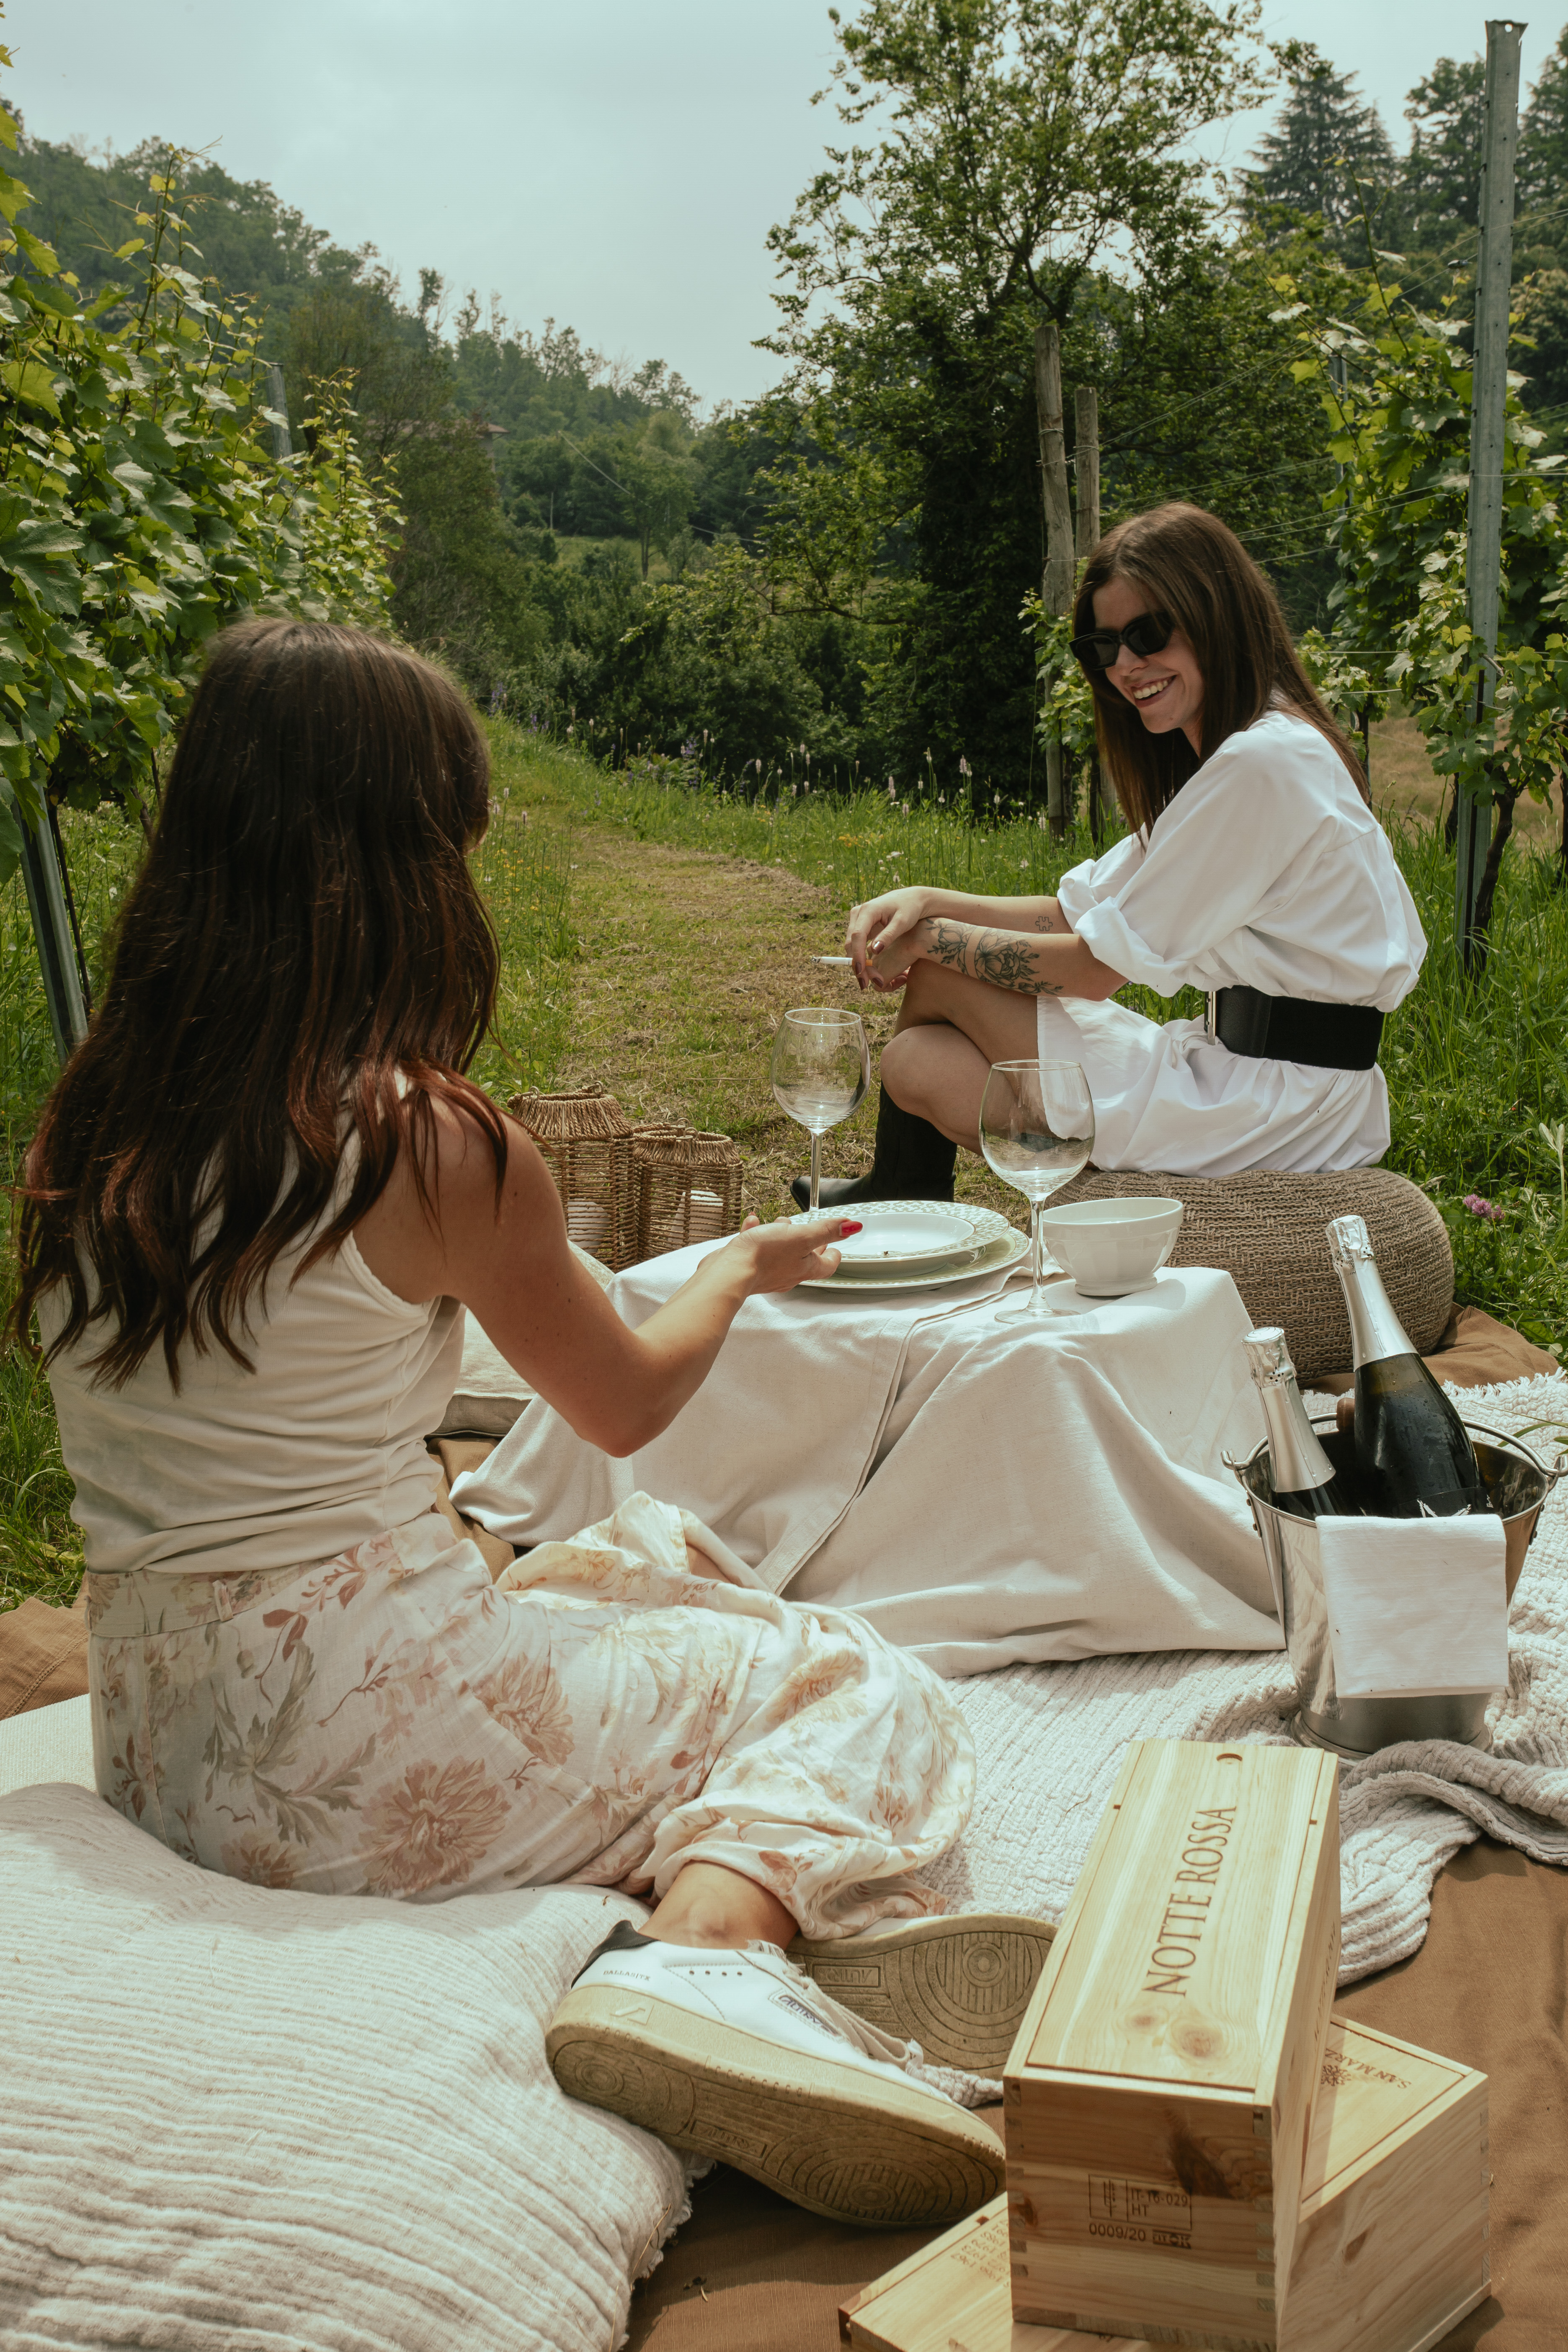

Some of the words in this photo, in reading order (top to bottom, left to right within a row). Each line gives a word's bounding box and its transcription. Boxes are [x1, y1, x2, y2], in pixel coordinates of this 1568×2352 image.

[1175, 1805, 1237, 1886] ROSSA
[1142, 1893, 1212, 1999] NOTTE
[1373, 2070, 1412, 2089] SAN
[1132, 2202, 1149, 2217] HT
[1089, 2222, 1147, 2242] 0009/20
